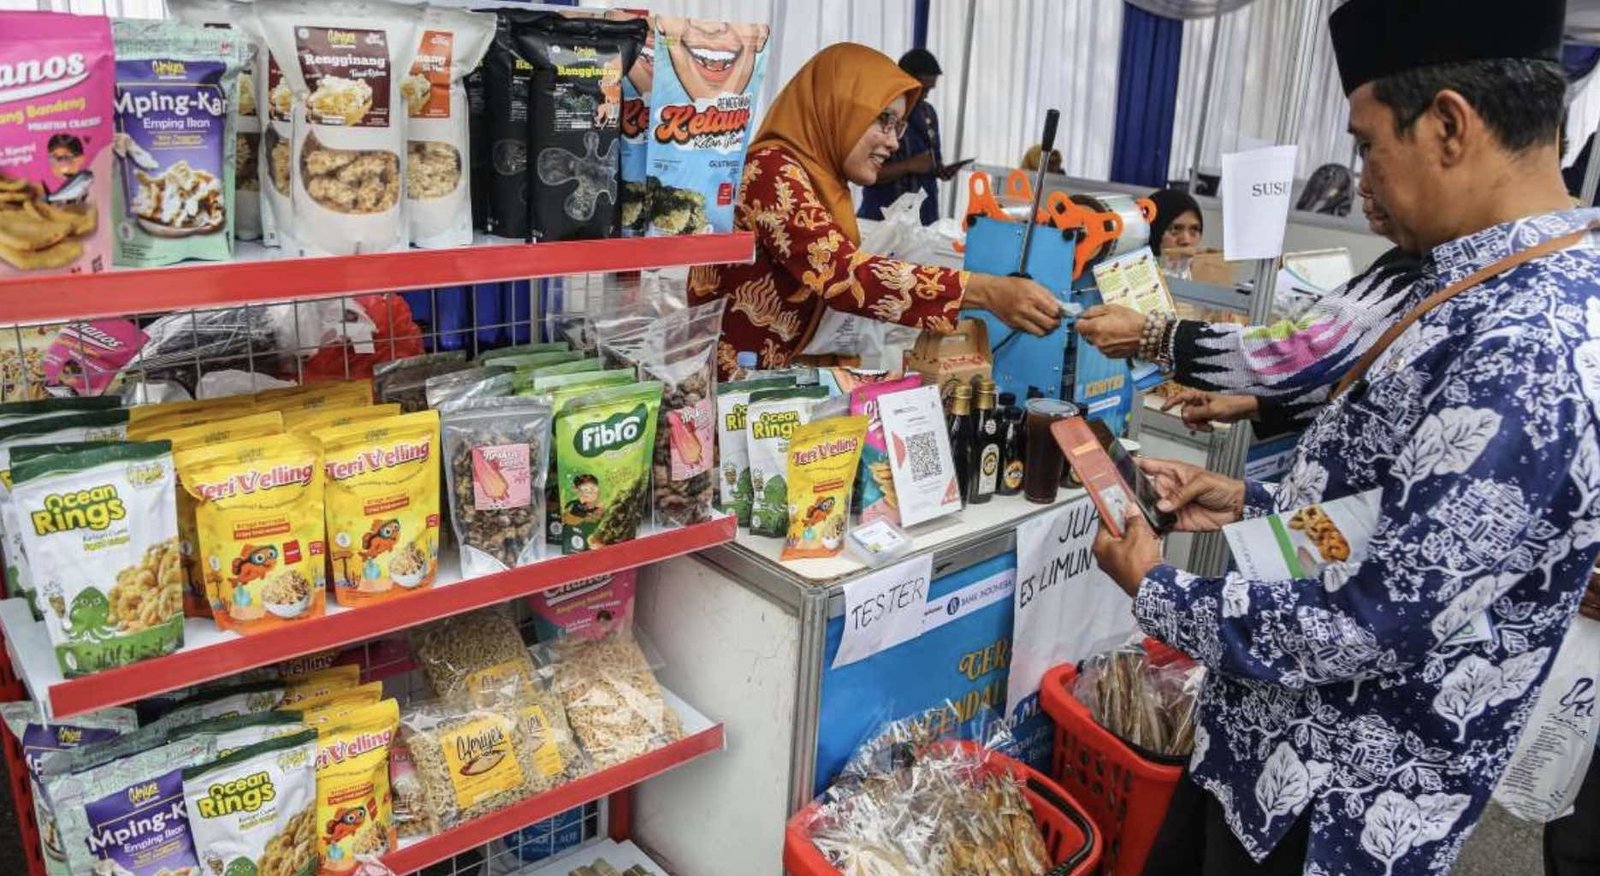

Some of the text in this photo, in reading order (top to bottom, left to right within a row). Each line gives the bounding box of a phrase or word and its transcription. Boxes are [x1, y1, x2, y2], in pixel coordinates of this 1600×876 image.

[304, 53, 386, 68] Rengginang
[143, 117, 210, 130] Emping Ikan
[1252, 181, 1290, 197] SUSU
[759, 411, 799, 424] Ocean
[582, 416, 641, 452] Fibro
[43, 483, 118, 510] Ocean
[31, 497, 127, 537] Rings
[851, 576, 926, 631] TESTER
[1020, 574, 1037, 609] ES
[208, 771, 270, 798] Ocean
[196, 782, 276, 819] Rings
